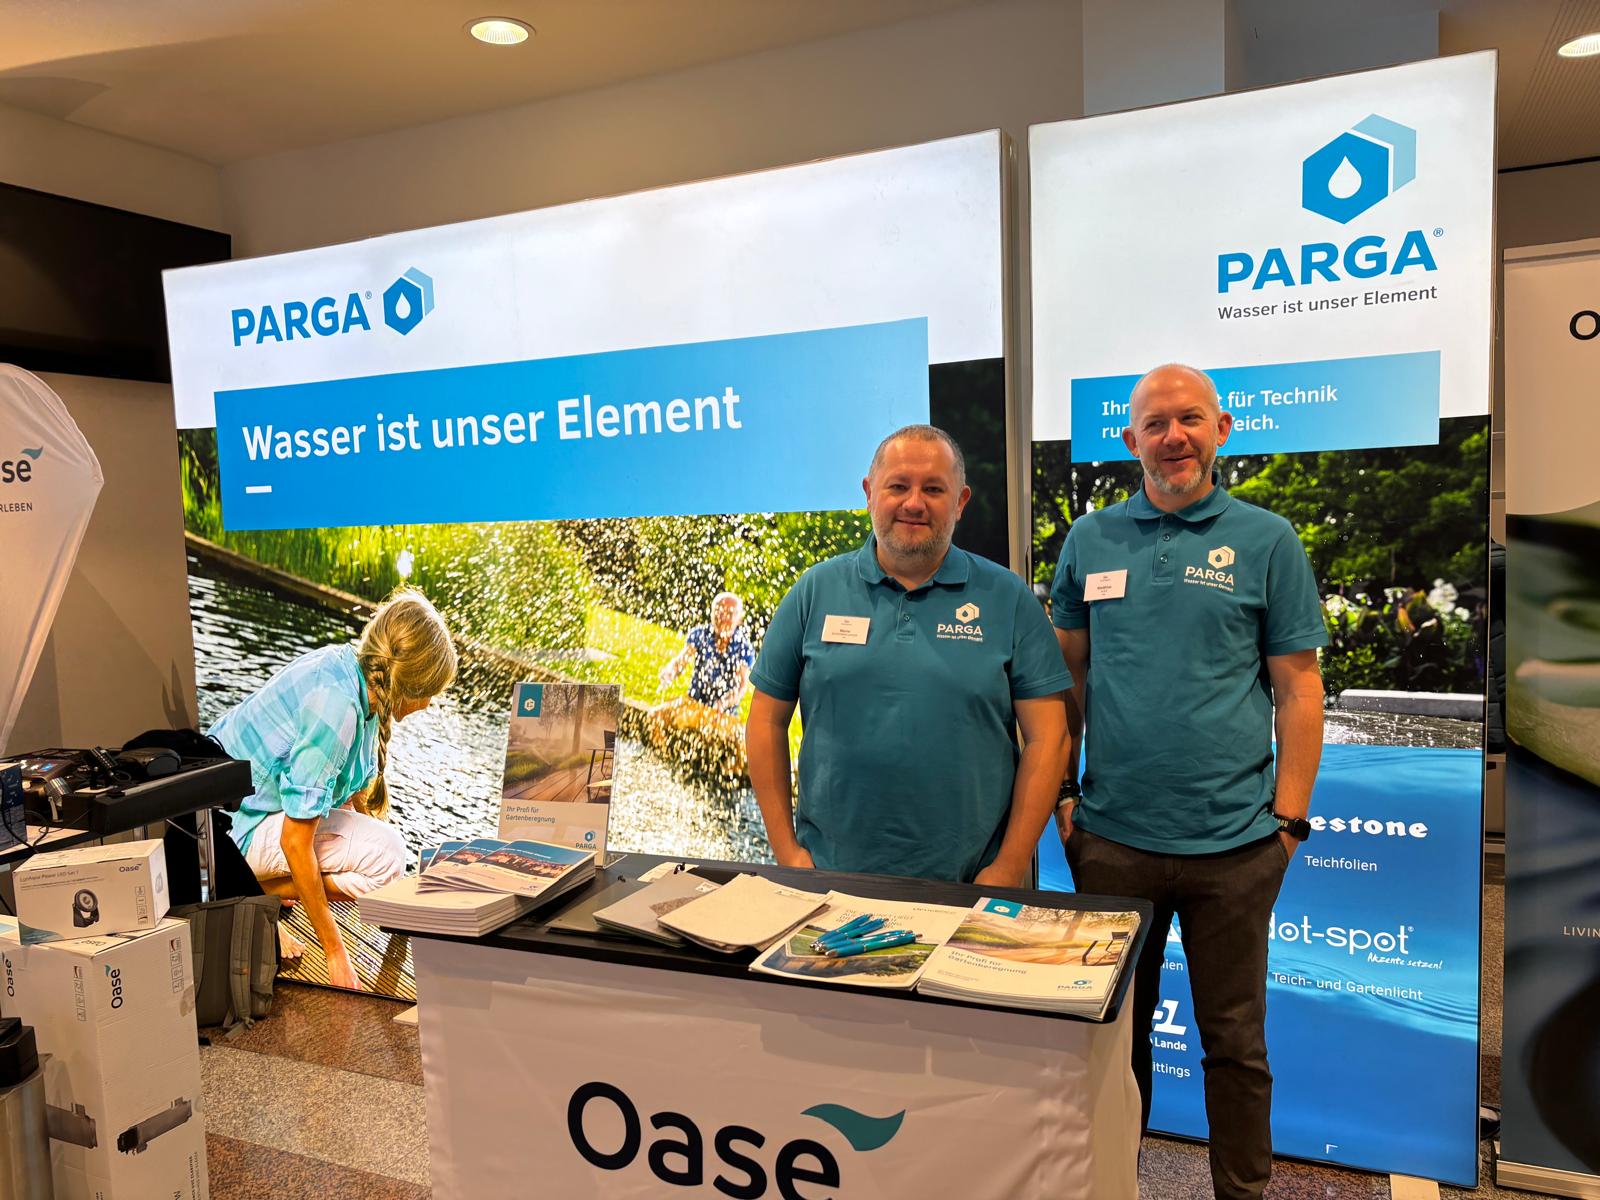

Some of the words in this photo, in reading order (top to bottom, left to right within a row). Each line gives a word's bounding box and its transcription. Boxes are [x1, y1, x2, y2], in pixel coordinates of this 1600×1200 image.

[1218, 230, 1438, 293] PARGA
[1218, 304, 1278, 320] Wasser
[1283, 300, 1303, 314] ist
[1308, 294, 1358, 311] unser
[1364, 286, 1438, 306] Element
[231, 292, 371, 347] PARGA
[1101, 400, 1130, 416] Ihr
[1228, 391, 1256, 409] für
[1260, 384, 1339, 406] Technik
[242, 424, 367, 461] Wasser
[376, 412, 421, 452] ist
[432, 410, 545, 450] unser
[557, 386, 743, 440] Element
[1232, 414, 1280, 432] eich.
[1185, 566, 1234, 586] PARGA
[937, 623, 983, 636] PARGA
[505, 814, 556, 824] Gartenberegnung
[1309, 815, 1428, 839] estone
[118, 865, 140, 873] Oase
[1304, 855, 1378, 872] Teichfolien
[1367, 951, 1405, 966] Akzente
[1407, 960, 1444, 970] setzen!
[5, 958, 15, 997] Oase
[110, 967, 123, 1009] Oase
[1272, 972, 1312, 986] Teich-
[1316, 979, 1342, 991] und
[1346, 981, 1424, 1000] Gartenlicht
[1154, 1037, 1188, 1052] Lande
[1152, 1061, 1191, 1078] ittings
[567, 1081, 840, 1200] Oase
